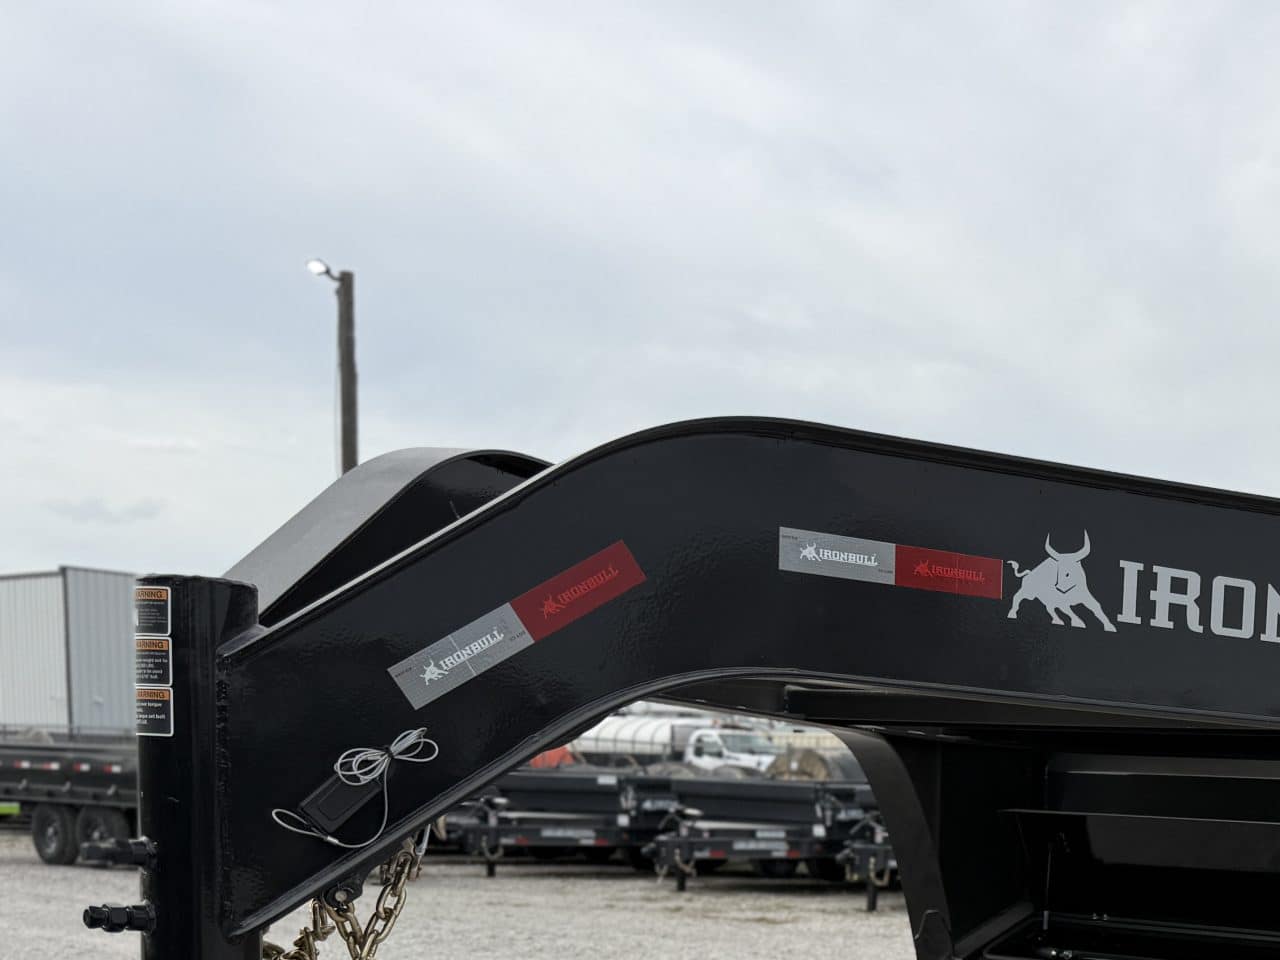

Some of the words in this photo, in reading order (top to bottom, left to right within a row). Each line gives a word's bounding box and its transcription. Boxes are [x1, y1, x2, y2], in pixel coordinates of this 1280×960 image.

[819, 549, 878, 567] IRONBULL
[558, 563, 620, 605] IRONBULL
[932, 566, 985, 582] IRONBULL
[439, 627, 504, 672] IRONBULL
